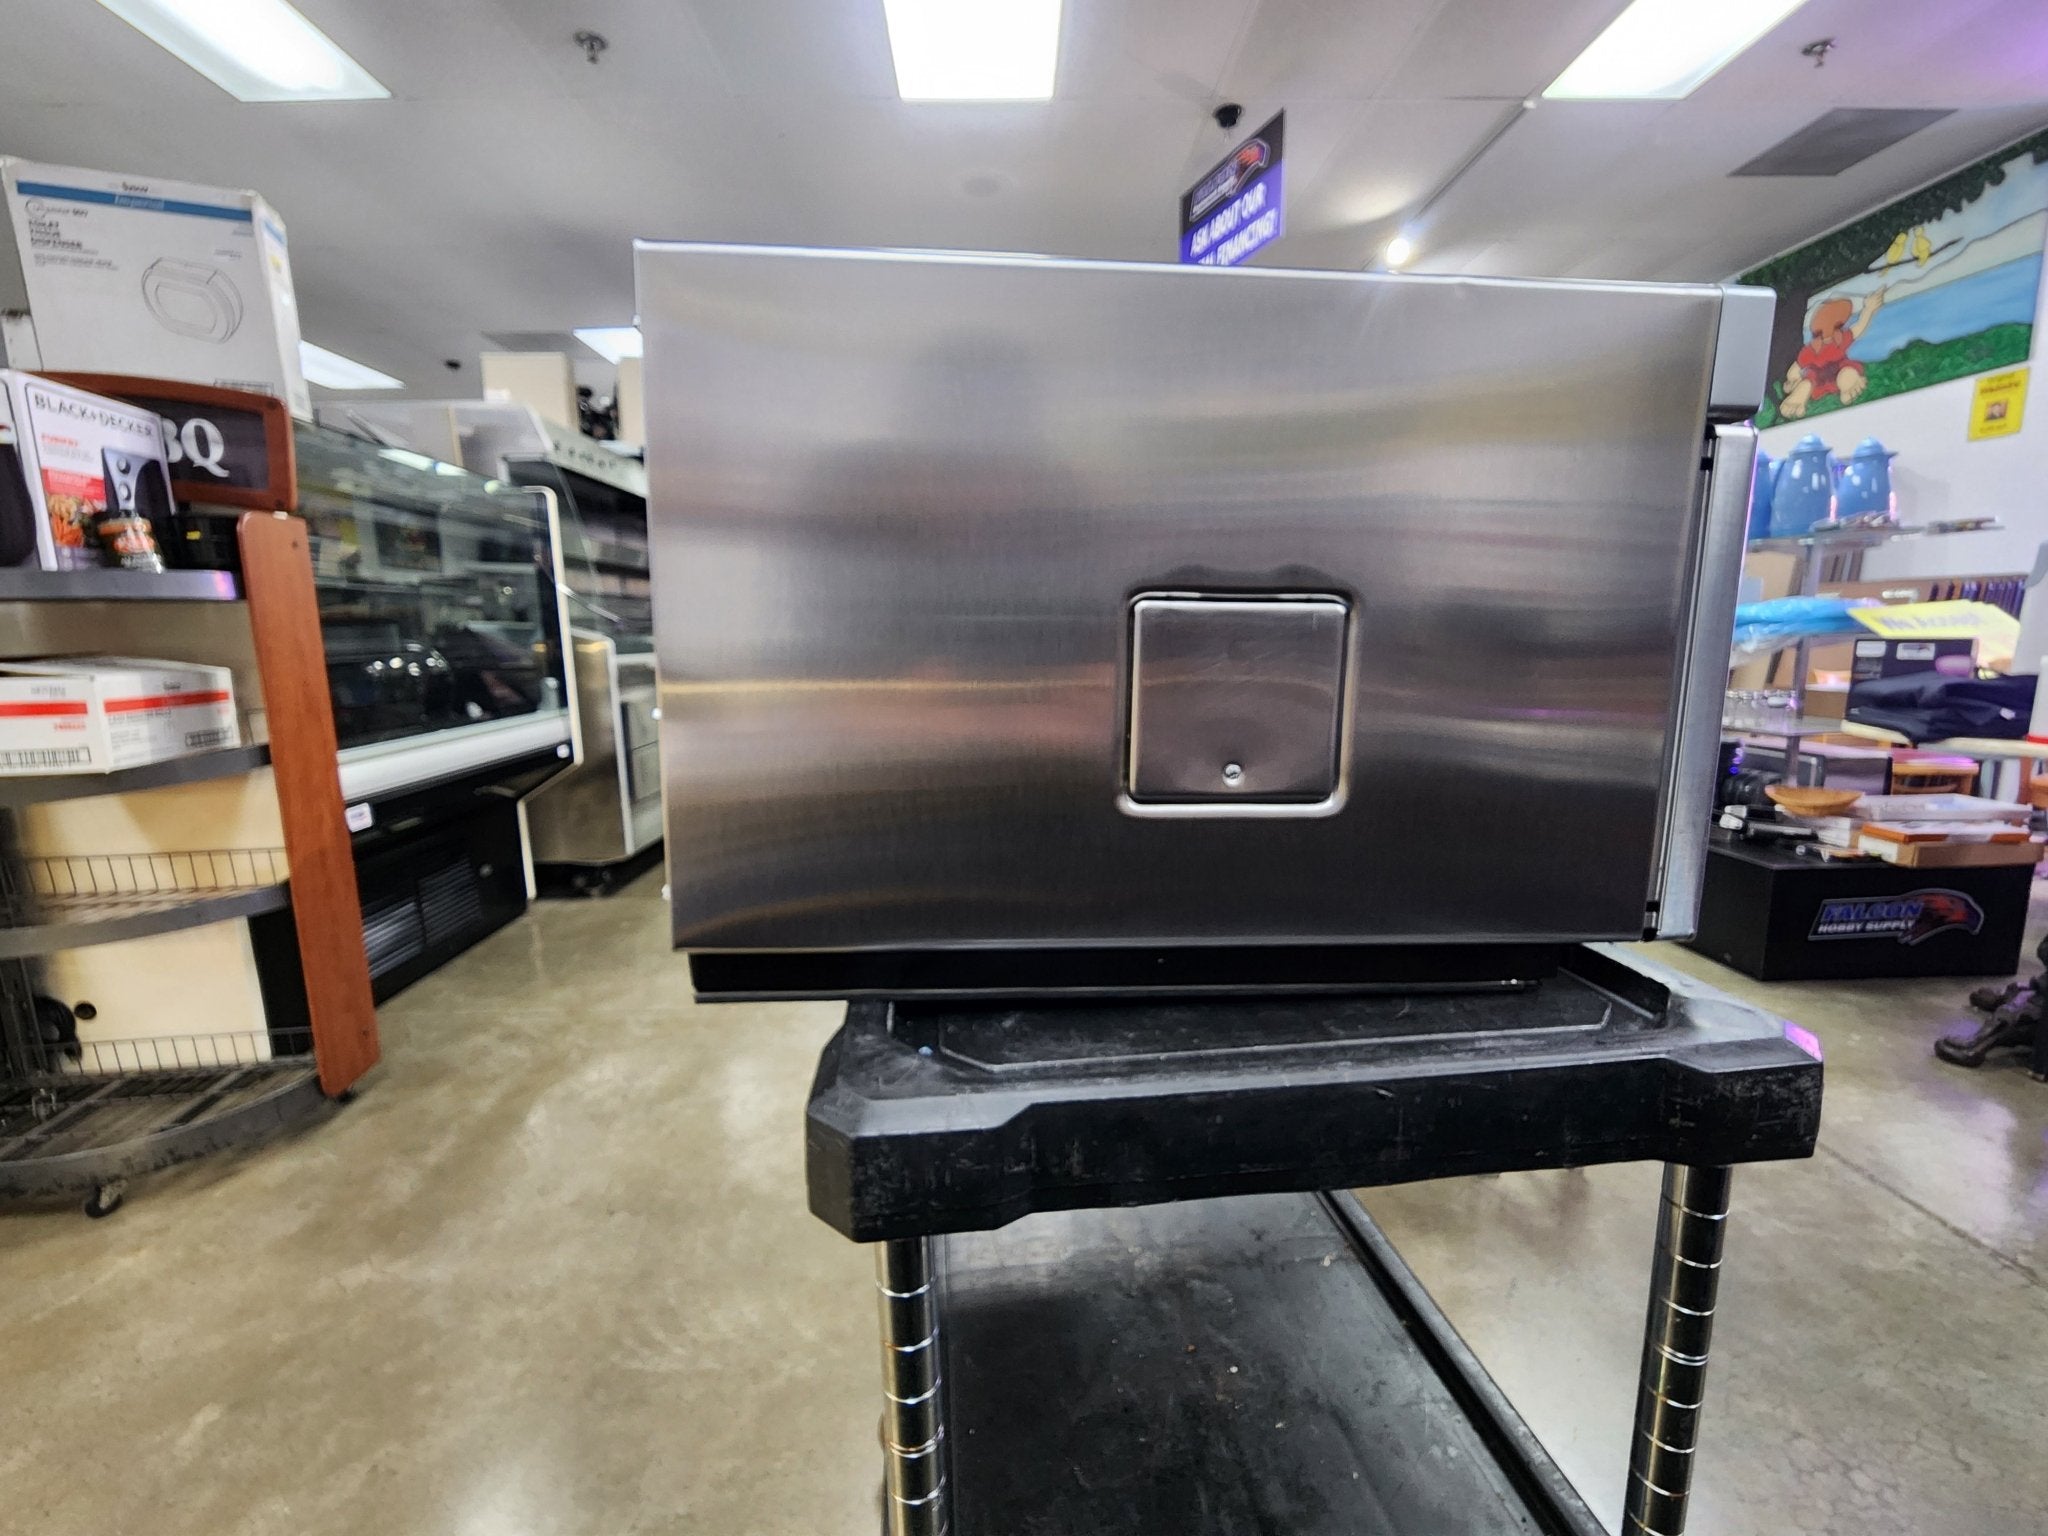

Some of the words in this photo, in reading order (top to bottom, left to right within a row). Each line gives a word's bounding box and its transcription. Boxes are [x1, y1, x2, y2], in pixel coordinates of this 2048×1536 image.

[1190, 222, 1212, 258] ASK
[1210, 198, 1242, 245] ABOUT
[1241, 181, 1266, 220] OUR
